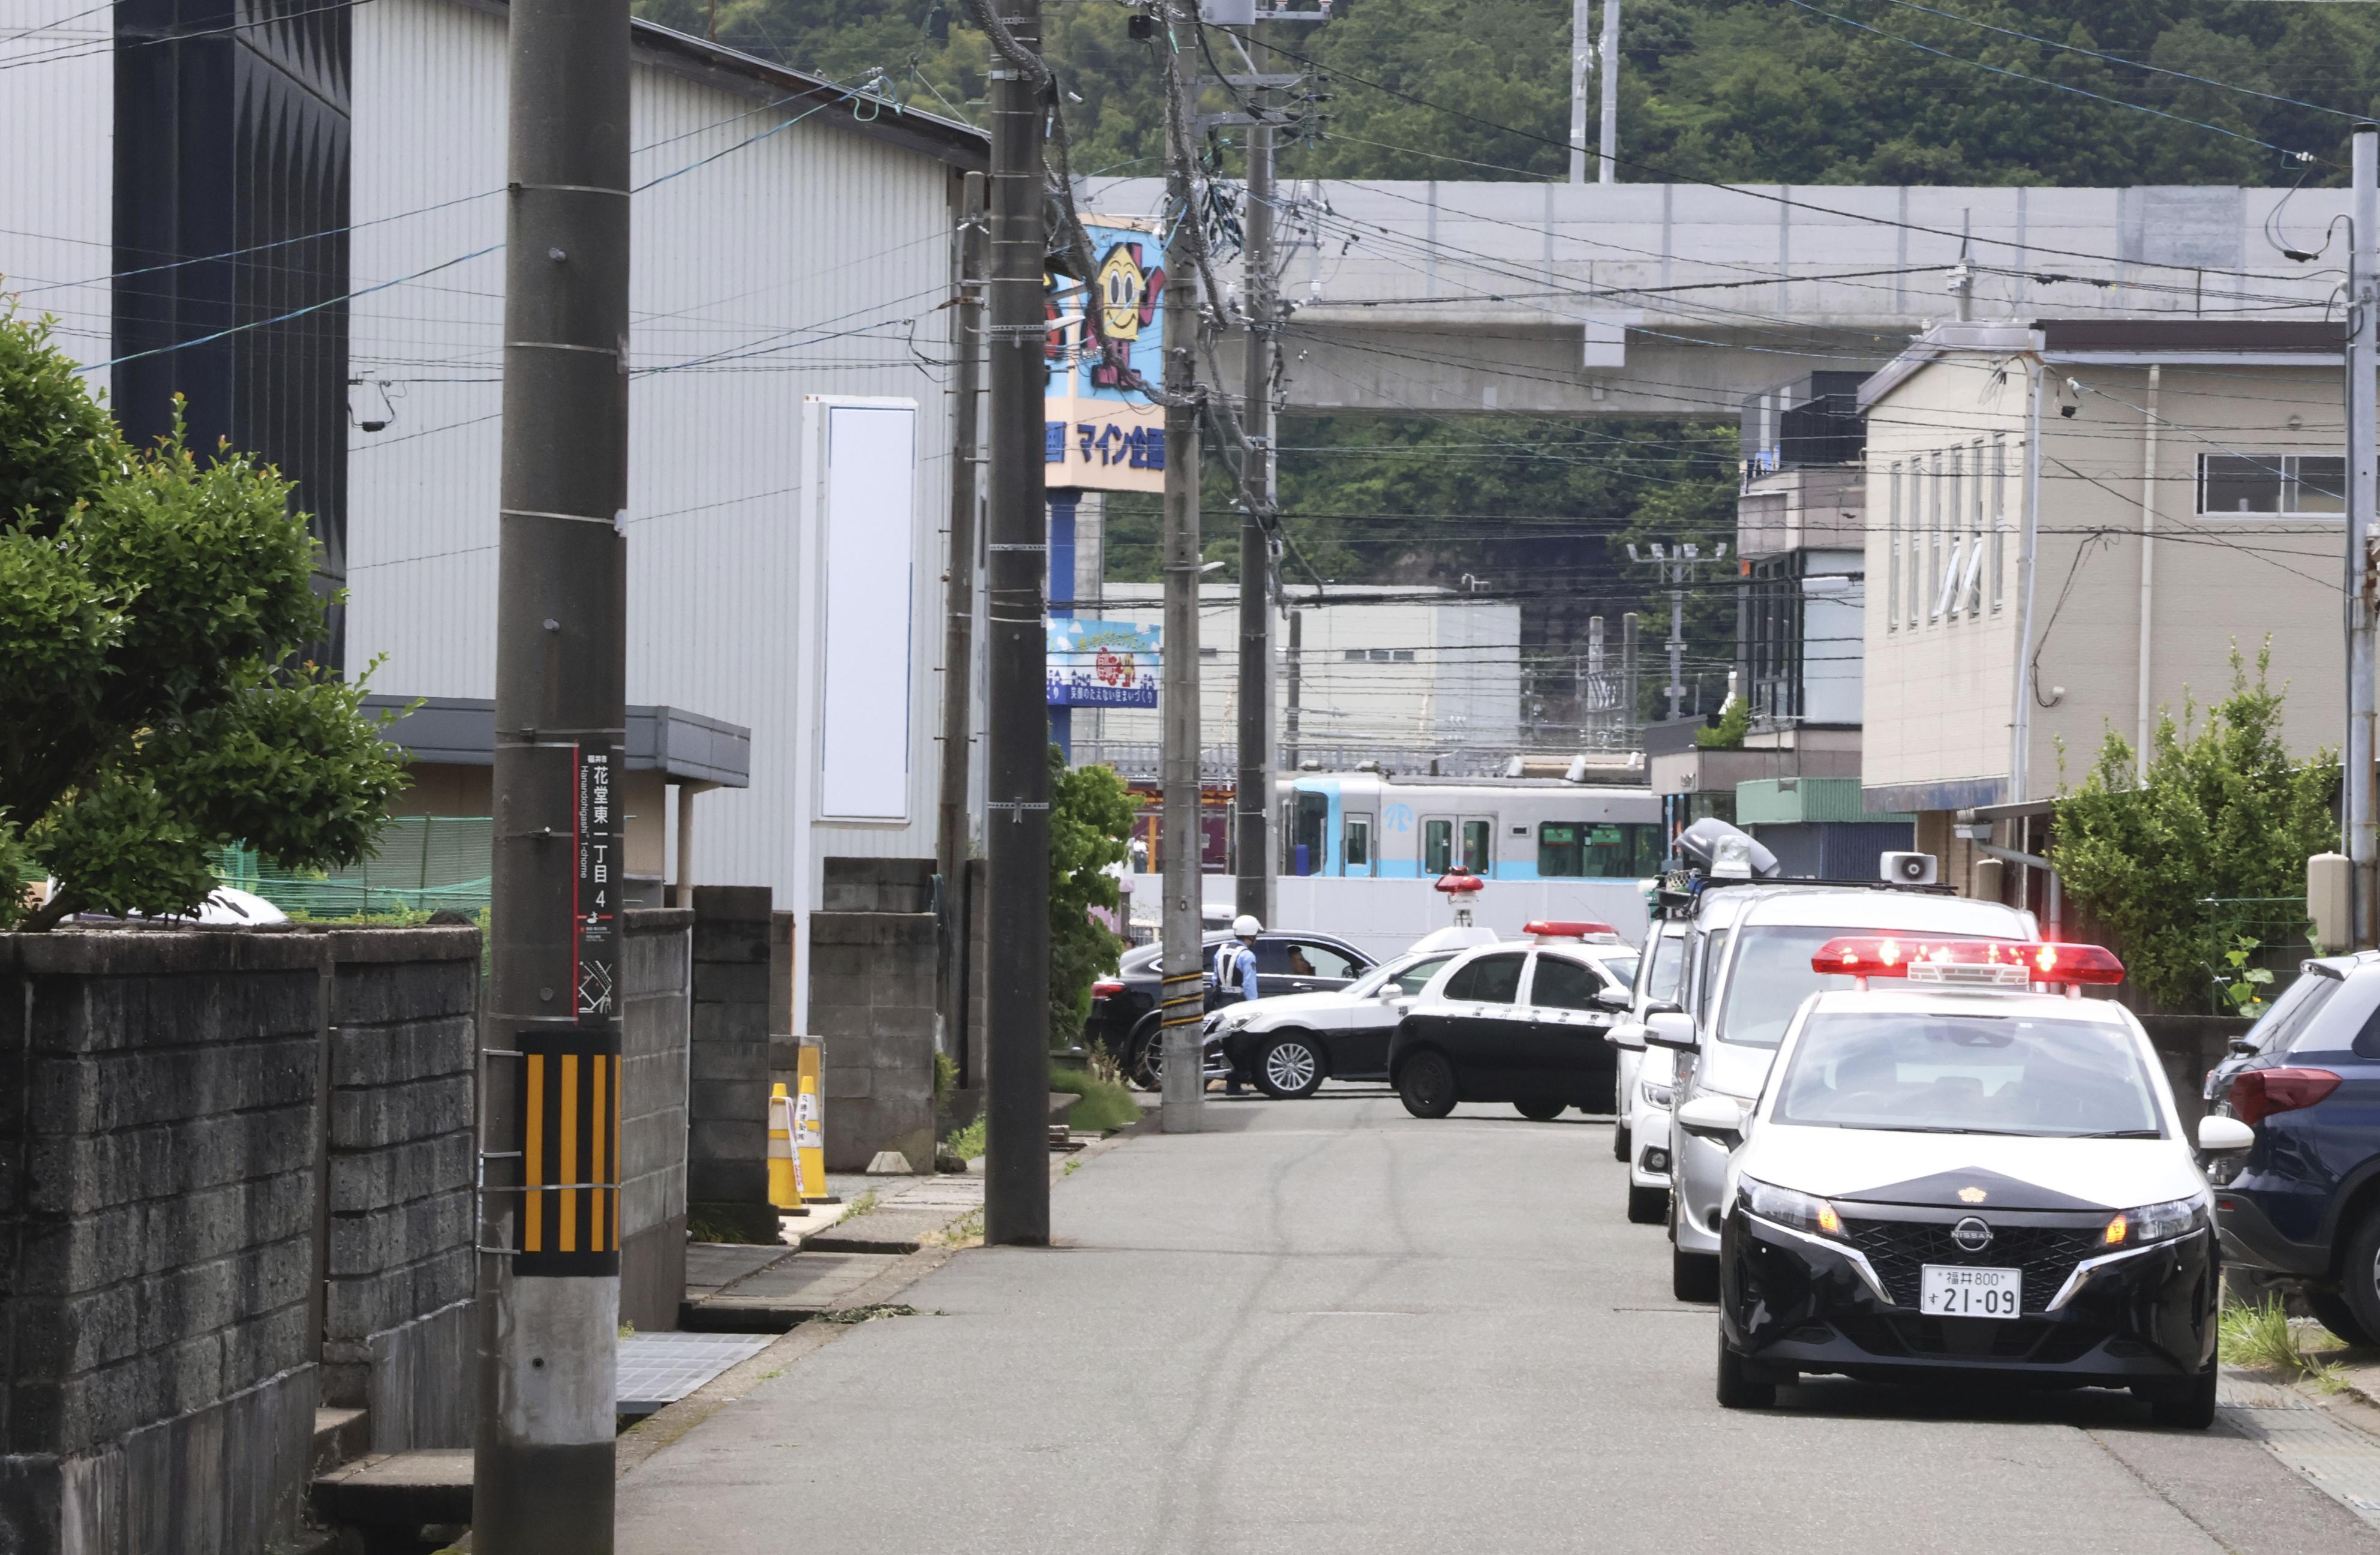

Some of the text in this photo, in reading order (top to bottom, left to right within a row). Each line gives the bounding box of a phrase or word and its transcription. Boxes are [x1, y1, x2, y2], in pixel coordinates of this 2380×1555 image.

[1077, 423, 1165, 471] マイン企画
[1071, 687, 1153, 704] 笑顔のたえない住まいづくり
[579, 766, 589, 879] Hanandohigashi 1-chome
[1951, 1231, 1994, 1240] NISSAN
[1944, 1288, 2014, 1314] 21-09
